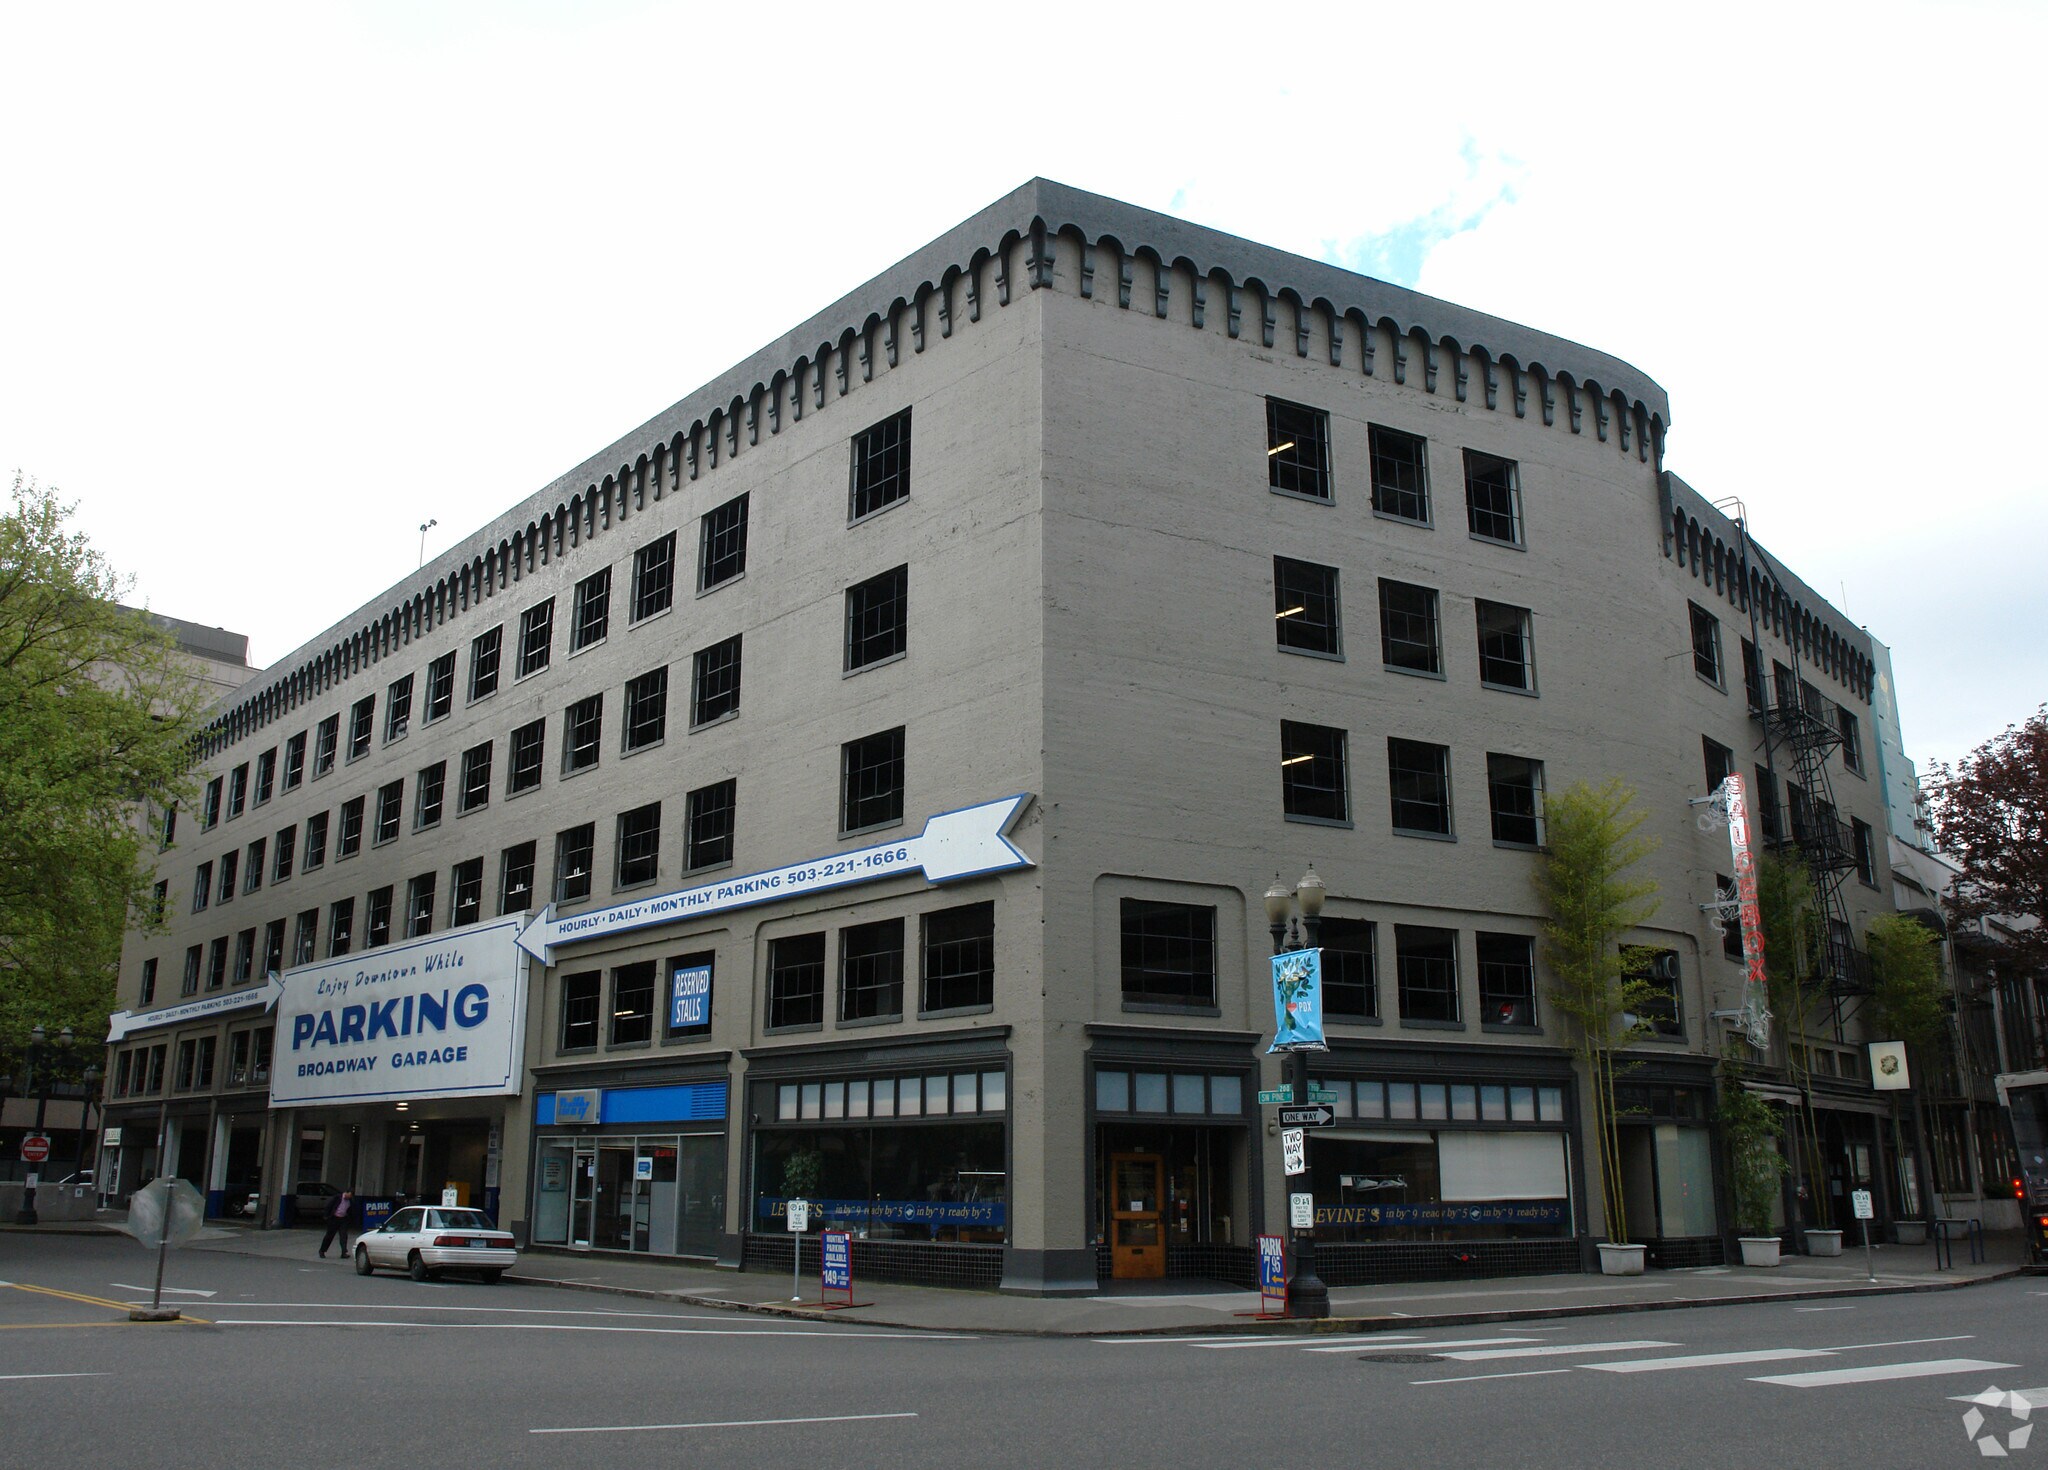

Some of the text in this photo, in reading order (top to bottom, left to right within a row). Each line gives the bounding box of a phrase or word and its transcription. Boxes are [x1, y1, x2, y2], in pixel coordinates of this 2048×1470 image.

[559, 847, 908, 934] HOURLY DAILY MONTHLY PARKING 503-221-1666
[317, 950, 464, 997] Enjoy Downtown While
[675, 969, 709, 997] RESERVED
[147, 1012, 163, 1022] HOURLY
[165, 1009, 178, 1019] DAILY
[180, 1005, 201, 1016] MONTHLY
[201, 1000, 222, 1012] PARKING
[676, 997, 701, 1023] STALLS
[1298, 1001, 1312, 1013] PDX
[292, 983, 490, 1051] PARKING
[298, 1046, 468, 1077] BROADWAY GARAGE
[1284, 1112, 1318, 1122] ONE WAY
[1283, 1131, 1302, 1144] TWO
[1284, 1143, 1302, 1155] WAY
[366, 1202, 390, 1211] PARK
[771, 1202, 823, 1217] LEE'S
[948, 1207, 970, 1219] ready
[1313, 1207, 1381, 1223] EVINE'S
[826, 1243, 846, 1253] PARKING
[1260, 1237, 1282, 1256] PARK
